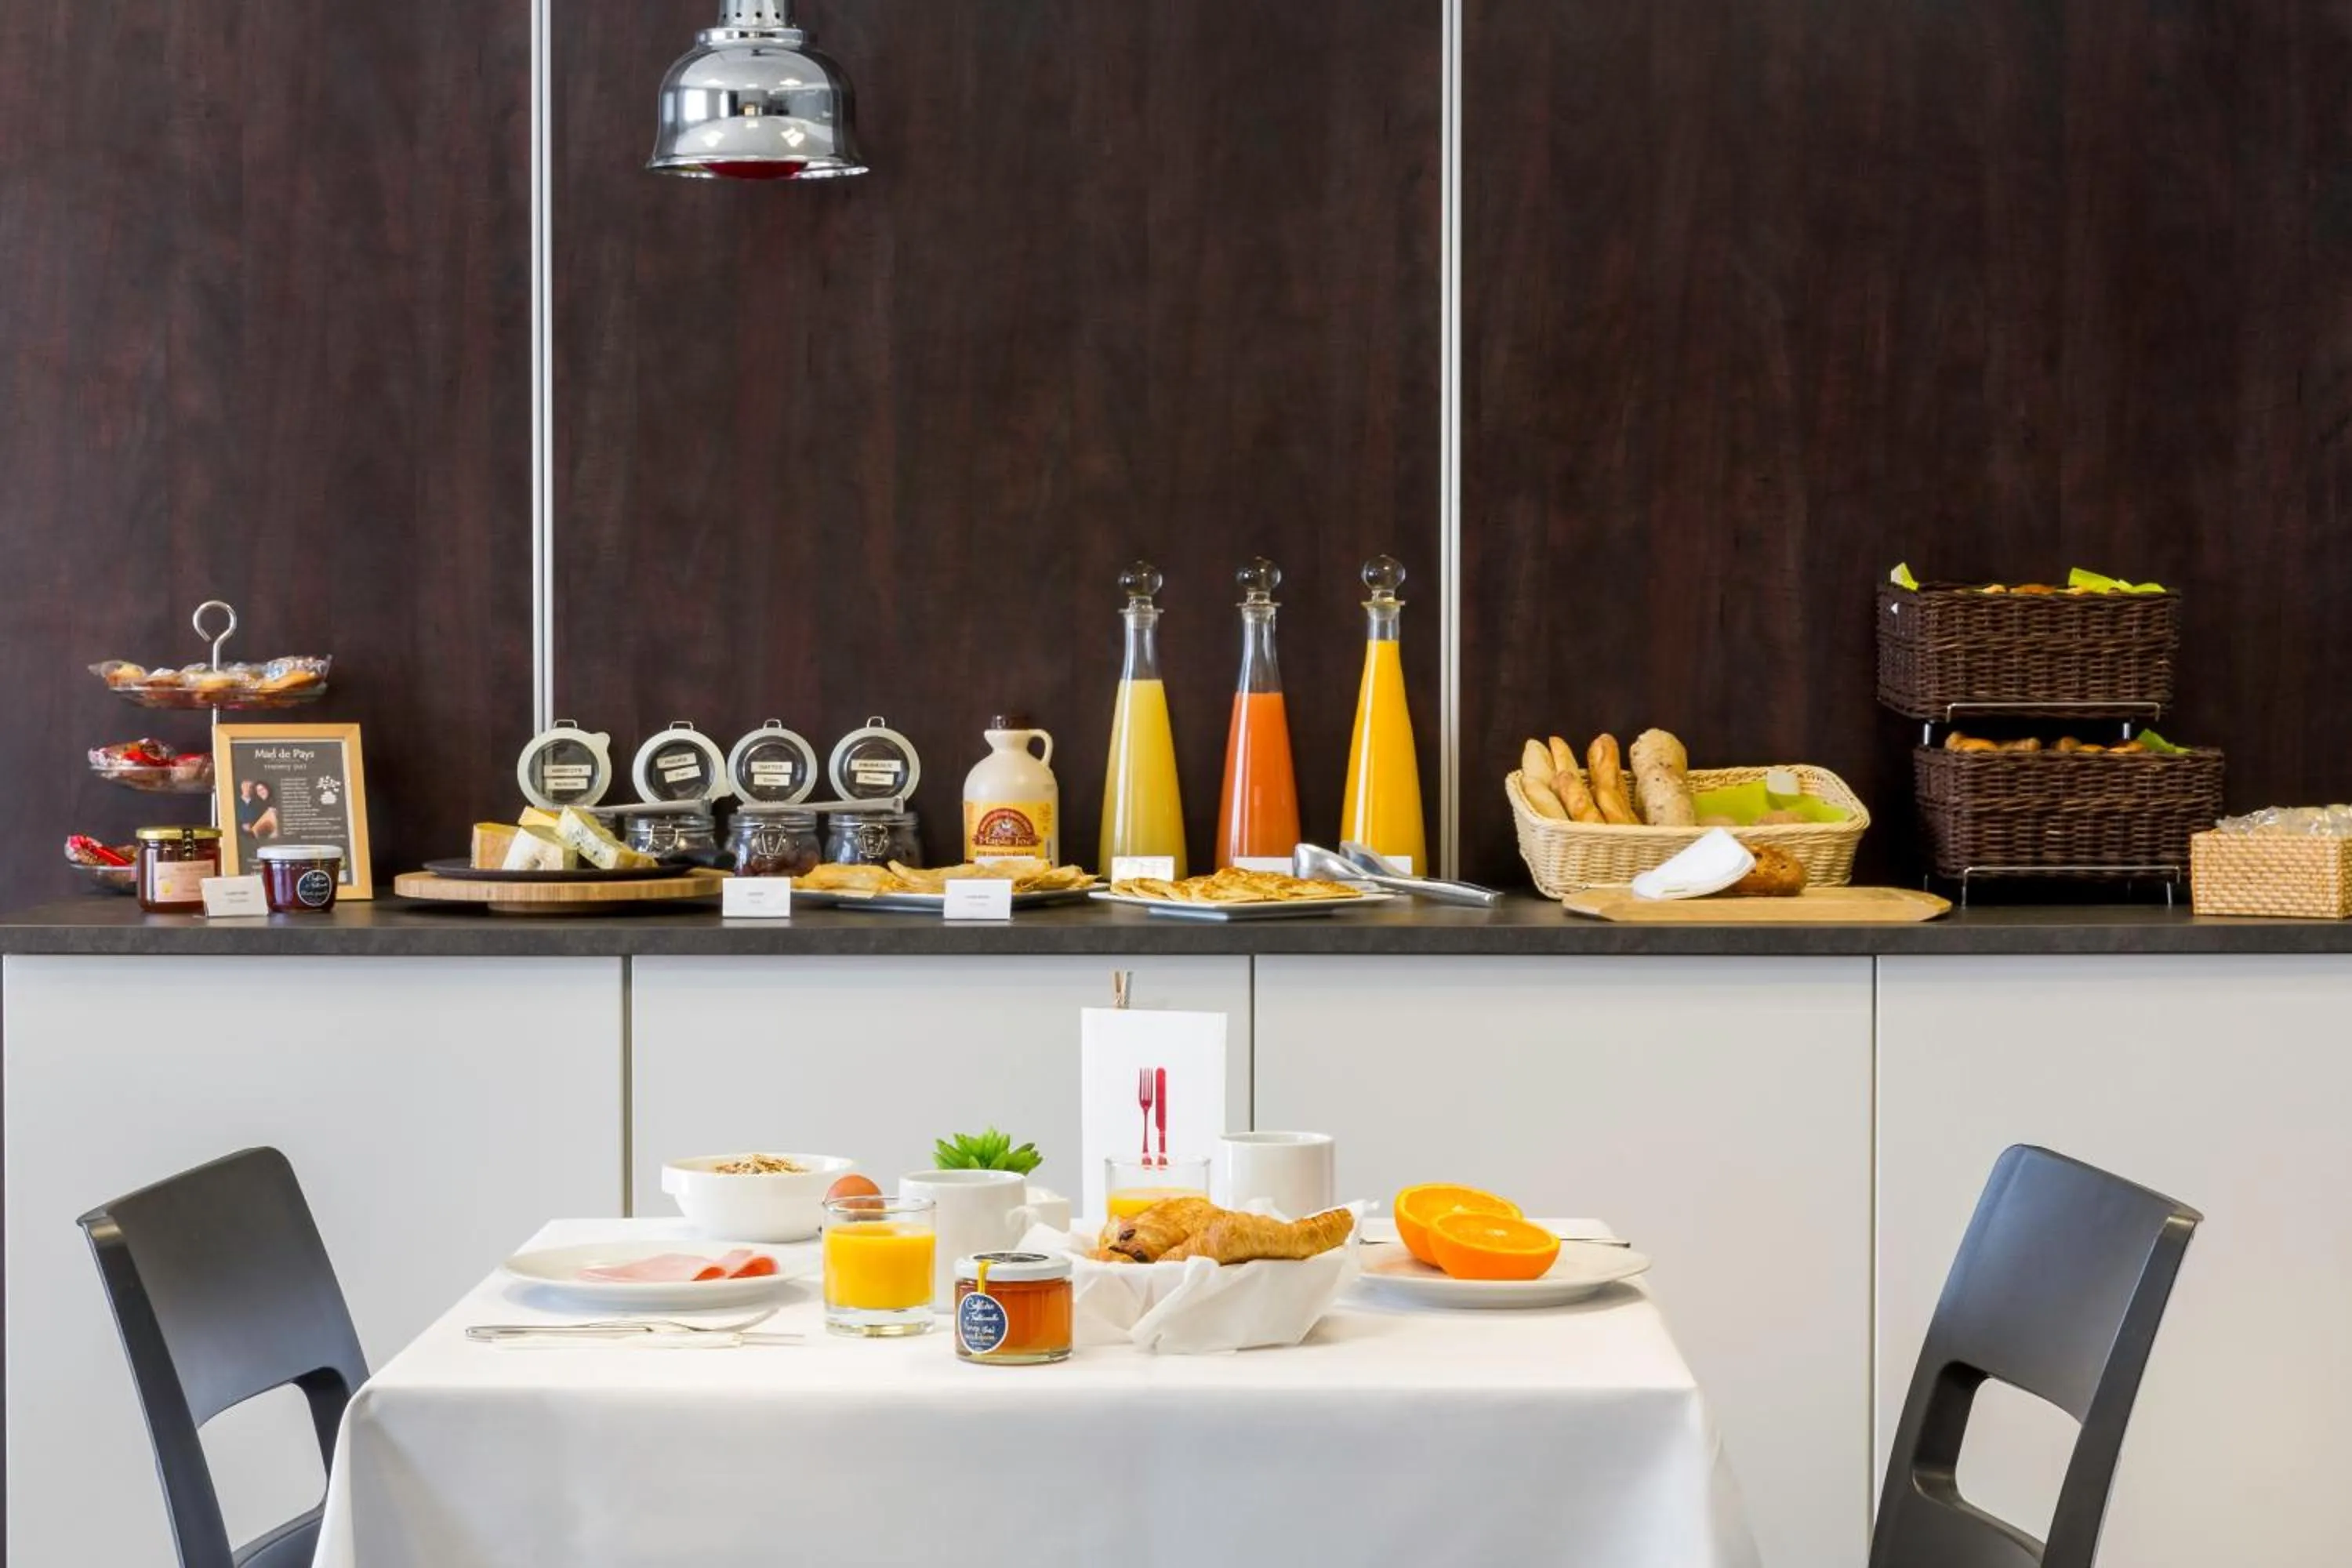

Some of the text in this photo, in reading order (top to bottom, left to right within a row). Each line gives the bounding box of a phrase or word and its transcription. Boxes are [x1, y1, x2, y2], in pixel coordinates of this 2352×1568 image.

[278, 748, 291, 758] de
[292, 748, 314, 760] Pays
[978, 836, 1031, 846] Maple Joe
